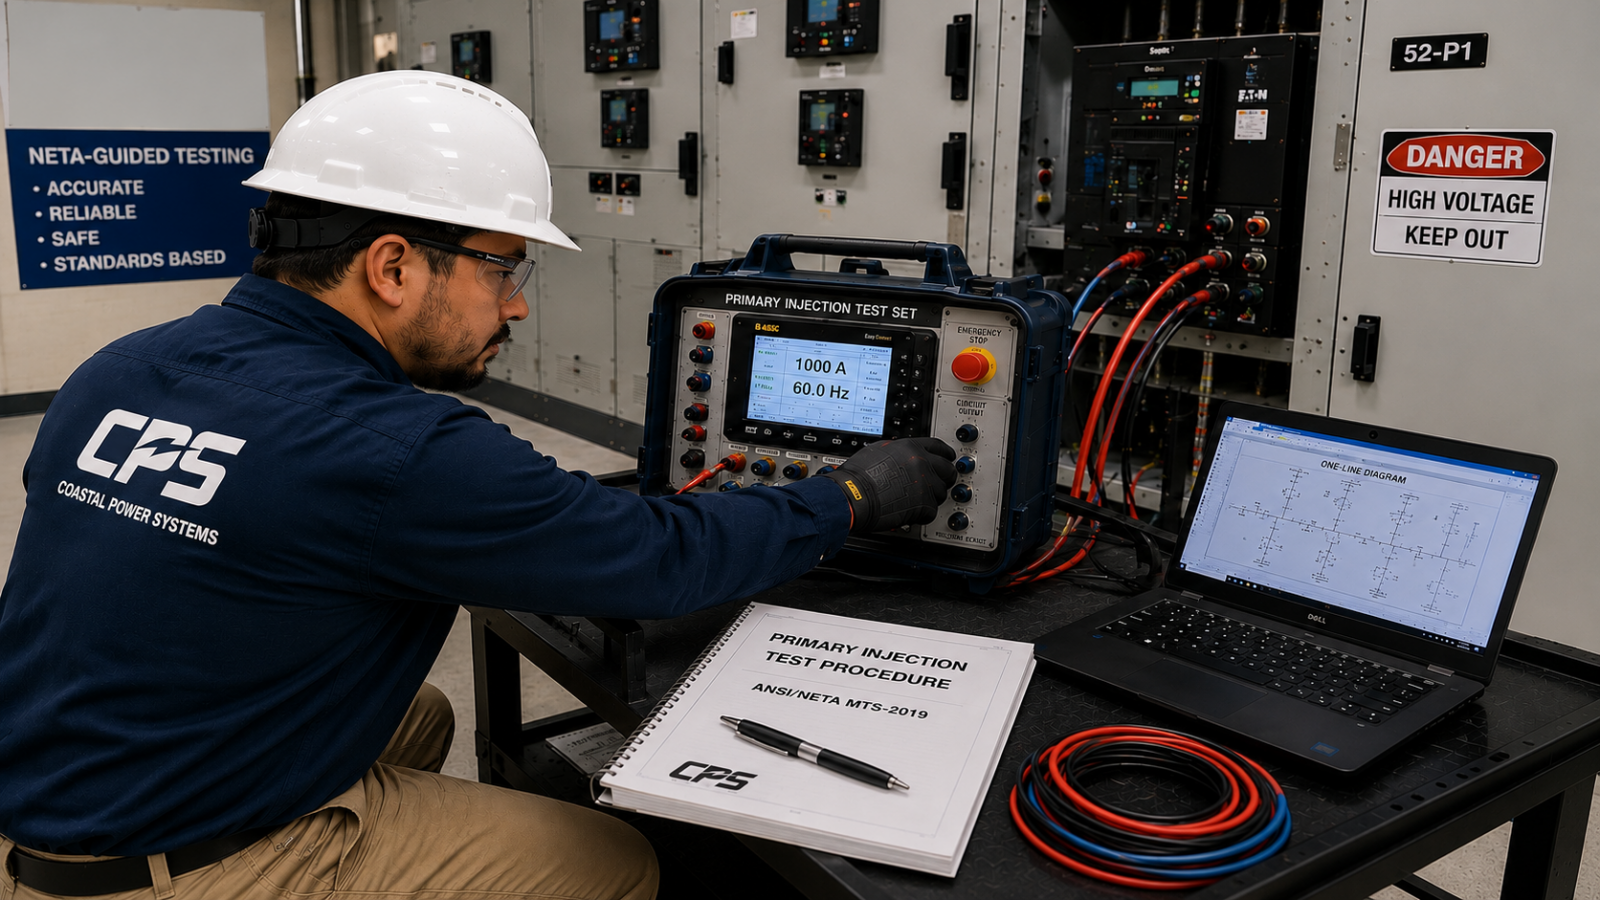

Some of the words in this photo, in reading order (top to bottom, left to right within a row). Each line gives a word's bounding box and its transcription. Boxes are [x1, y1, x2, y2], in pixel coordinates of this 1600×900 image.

[1403, 41, 1472, 63] 52-P1
[28, 147, 170, 165] NETA-GUIDED
[174, 147, 254, 164] TESTING
[1406, 144, 1524, 170] DANGER
[47, 179, 145, 196] ACCURATE
[49, 204, 137, 221] RELIABLE
[1387, 189, 1436, 210] HIGH
[1443, 191, 1535, 215] VOLTAGE
[51, 230, 100, 247] SAFE
[1405, 225, 1459, 247] KEEP
[1464, 228, 1509, 250] OUT
[54, 252, 164, 272] STANDARDS
[168, 249, 227, 267] BASED
[725, 293, 781, 309] PRIMARY
[785, 298, 851, 314] INJECTION
[855, 303, 888, 318] TEST
[891, 306, 918, 320] SET
[969, 336, 988, 344] STOP
[795, 357, 832, 374] 1000
[834, 361, 847, 375] A
[792, 381, 826, 397] 60.0
[829, 384, 850, 400] Hz
[76, 408, 247, 507] CPS
[1320, 460, 1362, 476] ONE-LINE
[1363, 468, 1407, 485] DIAGRAM
[57, 480, 105, 510] COASTAL
[107, 497, 151, 524] POWER
[151, 512, 219, 546] SYSTEMS
[768, 632, 859, 657] PRIMARY
[860, 647, 969, 672] INJECTION
[764, 650, 817, 667] TEST
[819, 659, 952, 690] PROCEDURE
[751, 682, 842, 706] ANSI/NETA
[844, 698, 929, 720] MTS-2019
[668, 760, 758, 792] CPS
